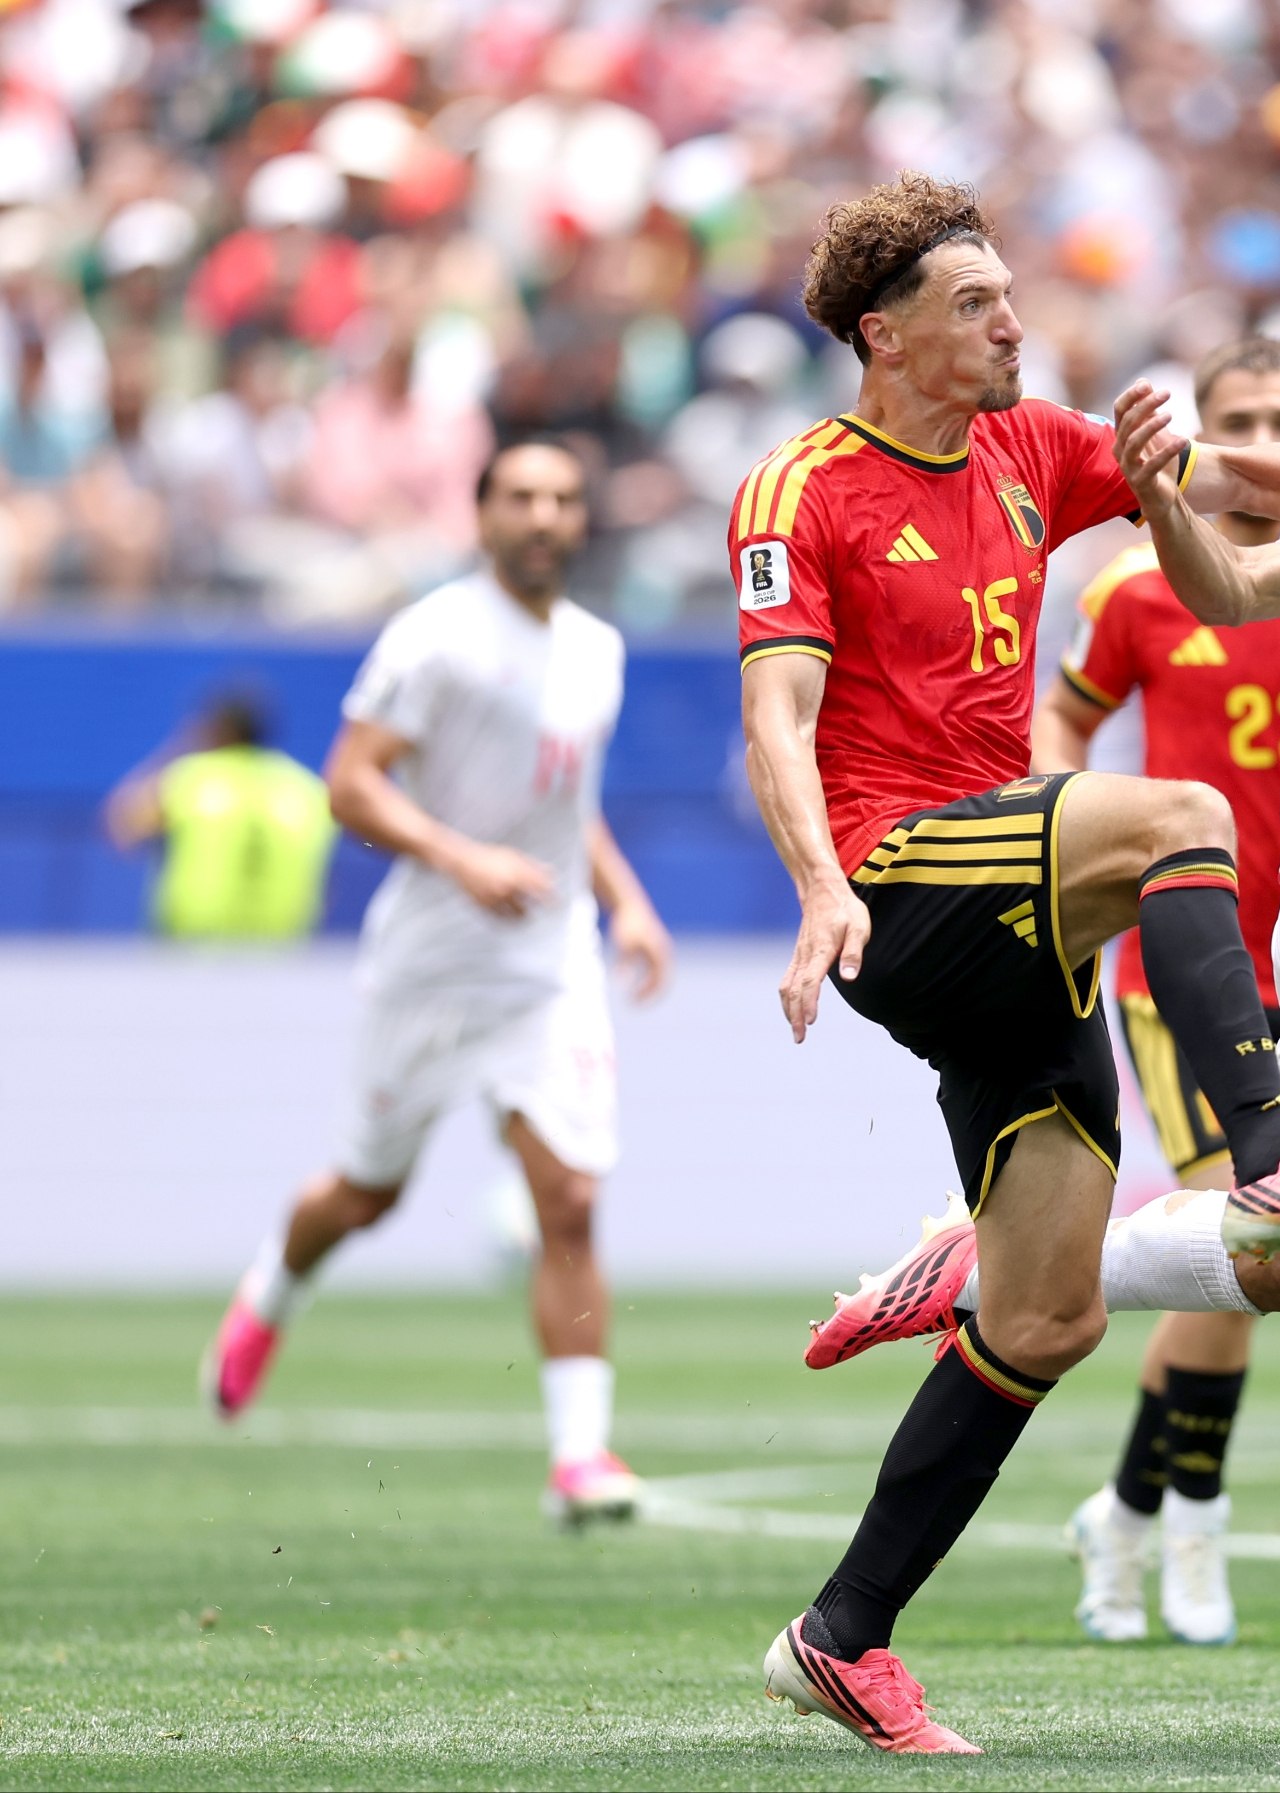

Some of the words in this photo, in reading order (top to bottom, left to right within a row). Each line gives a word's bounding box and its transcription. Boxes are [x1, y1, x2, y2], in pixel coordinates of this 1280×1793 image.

[756, 581, 768, 589] FIFA
[753, 594, 777, 605] 2026
[961, 576, 1021, 672] 15
